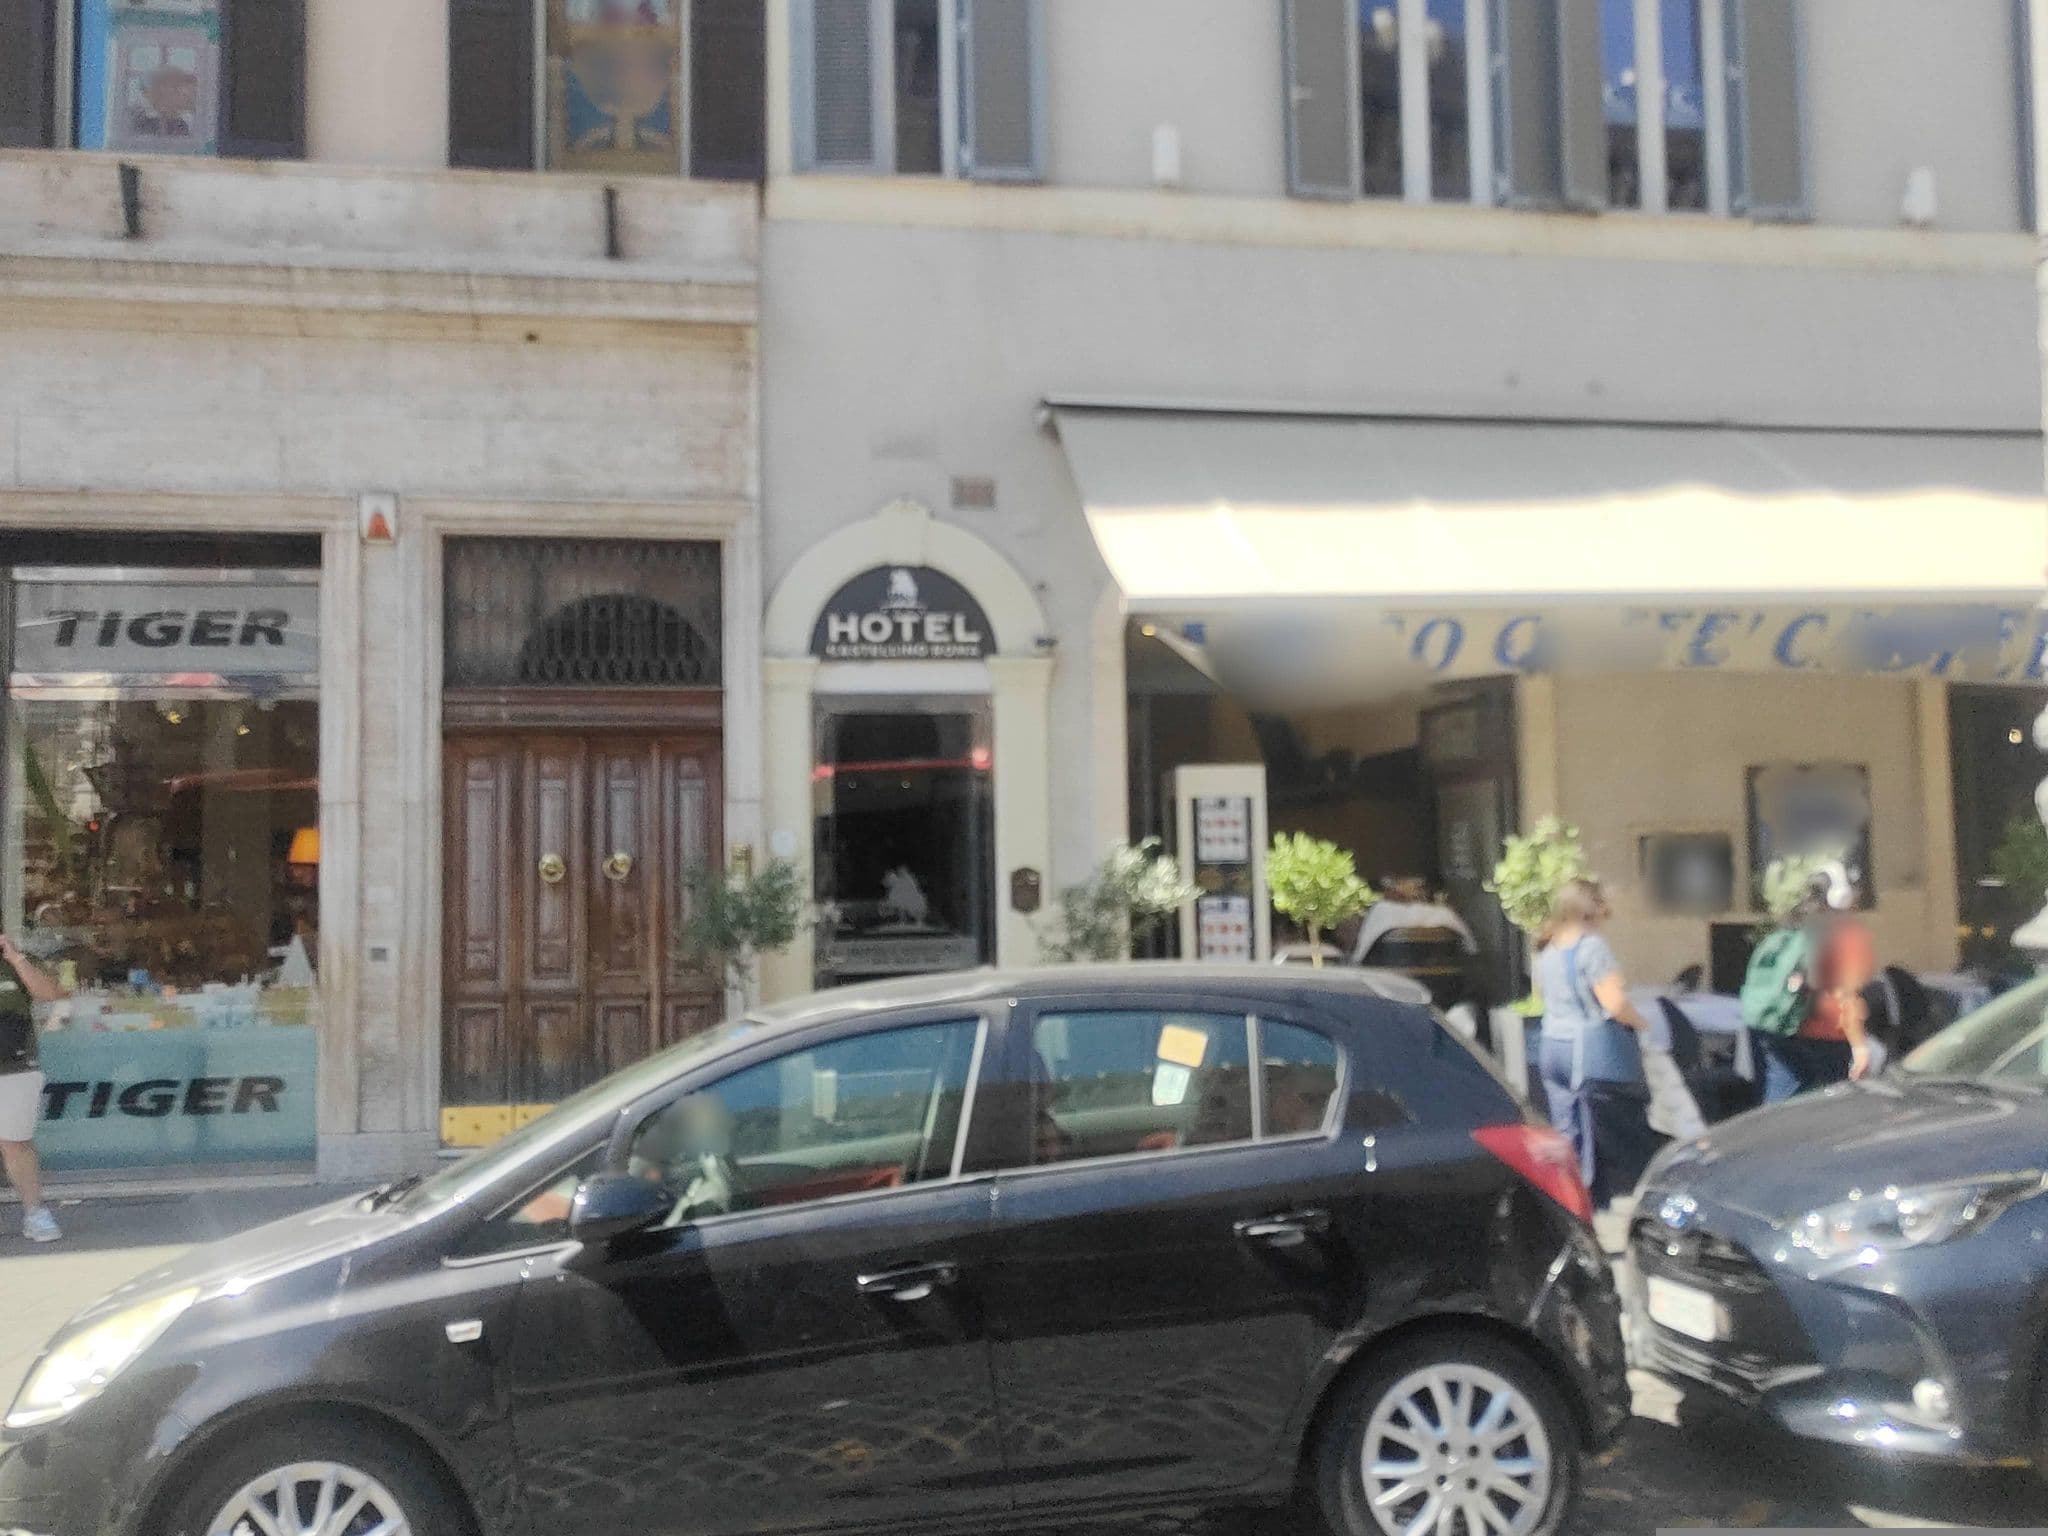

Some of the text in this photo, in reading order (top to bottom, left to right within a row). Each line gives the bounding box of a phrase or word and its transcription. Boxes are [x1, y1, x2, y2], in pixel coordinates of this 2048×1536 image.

[47, 609, 289, 648] TIGER
[828, 612, 981, 643] HOTEL
[42, 1076, 286, 1120] TIGER
